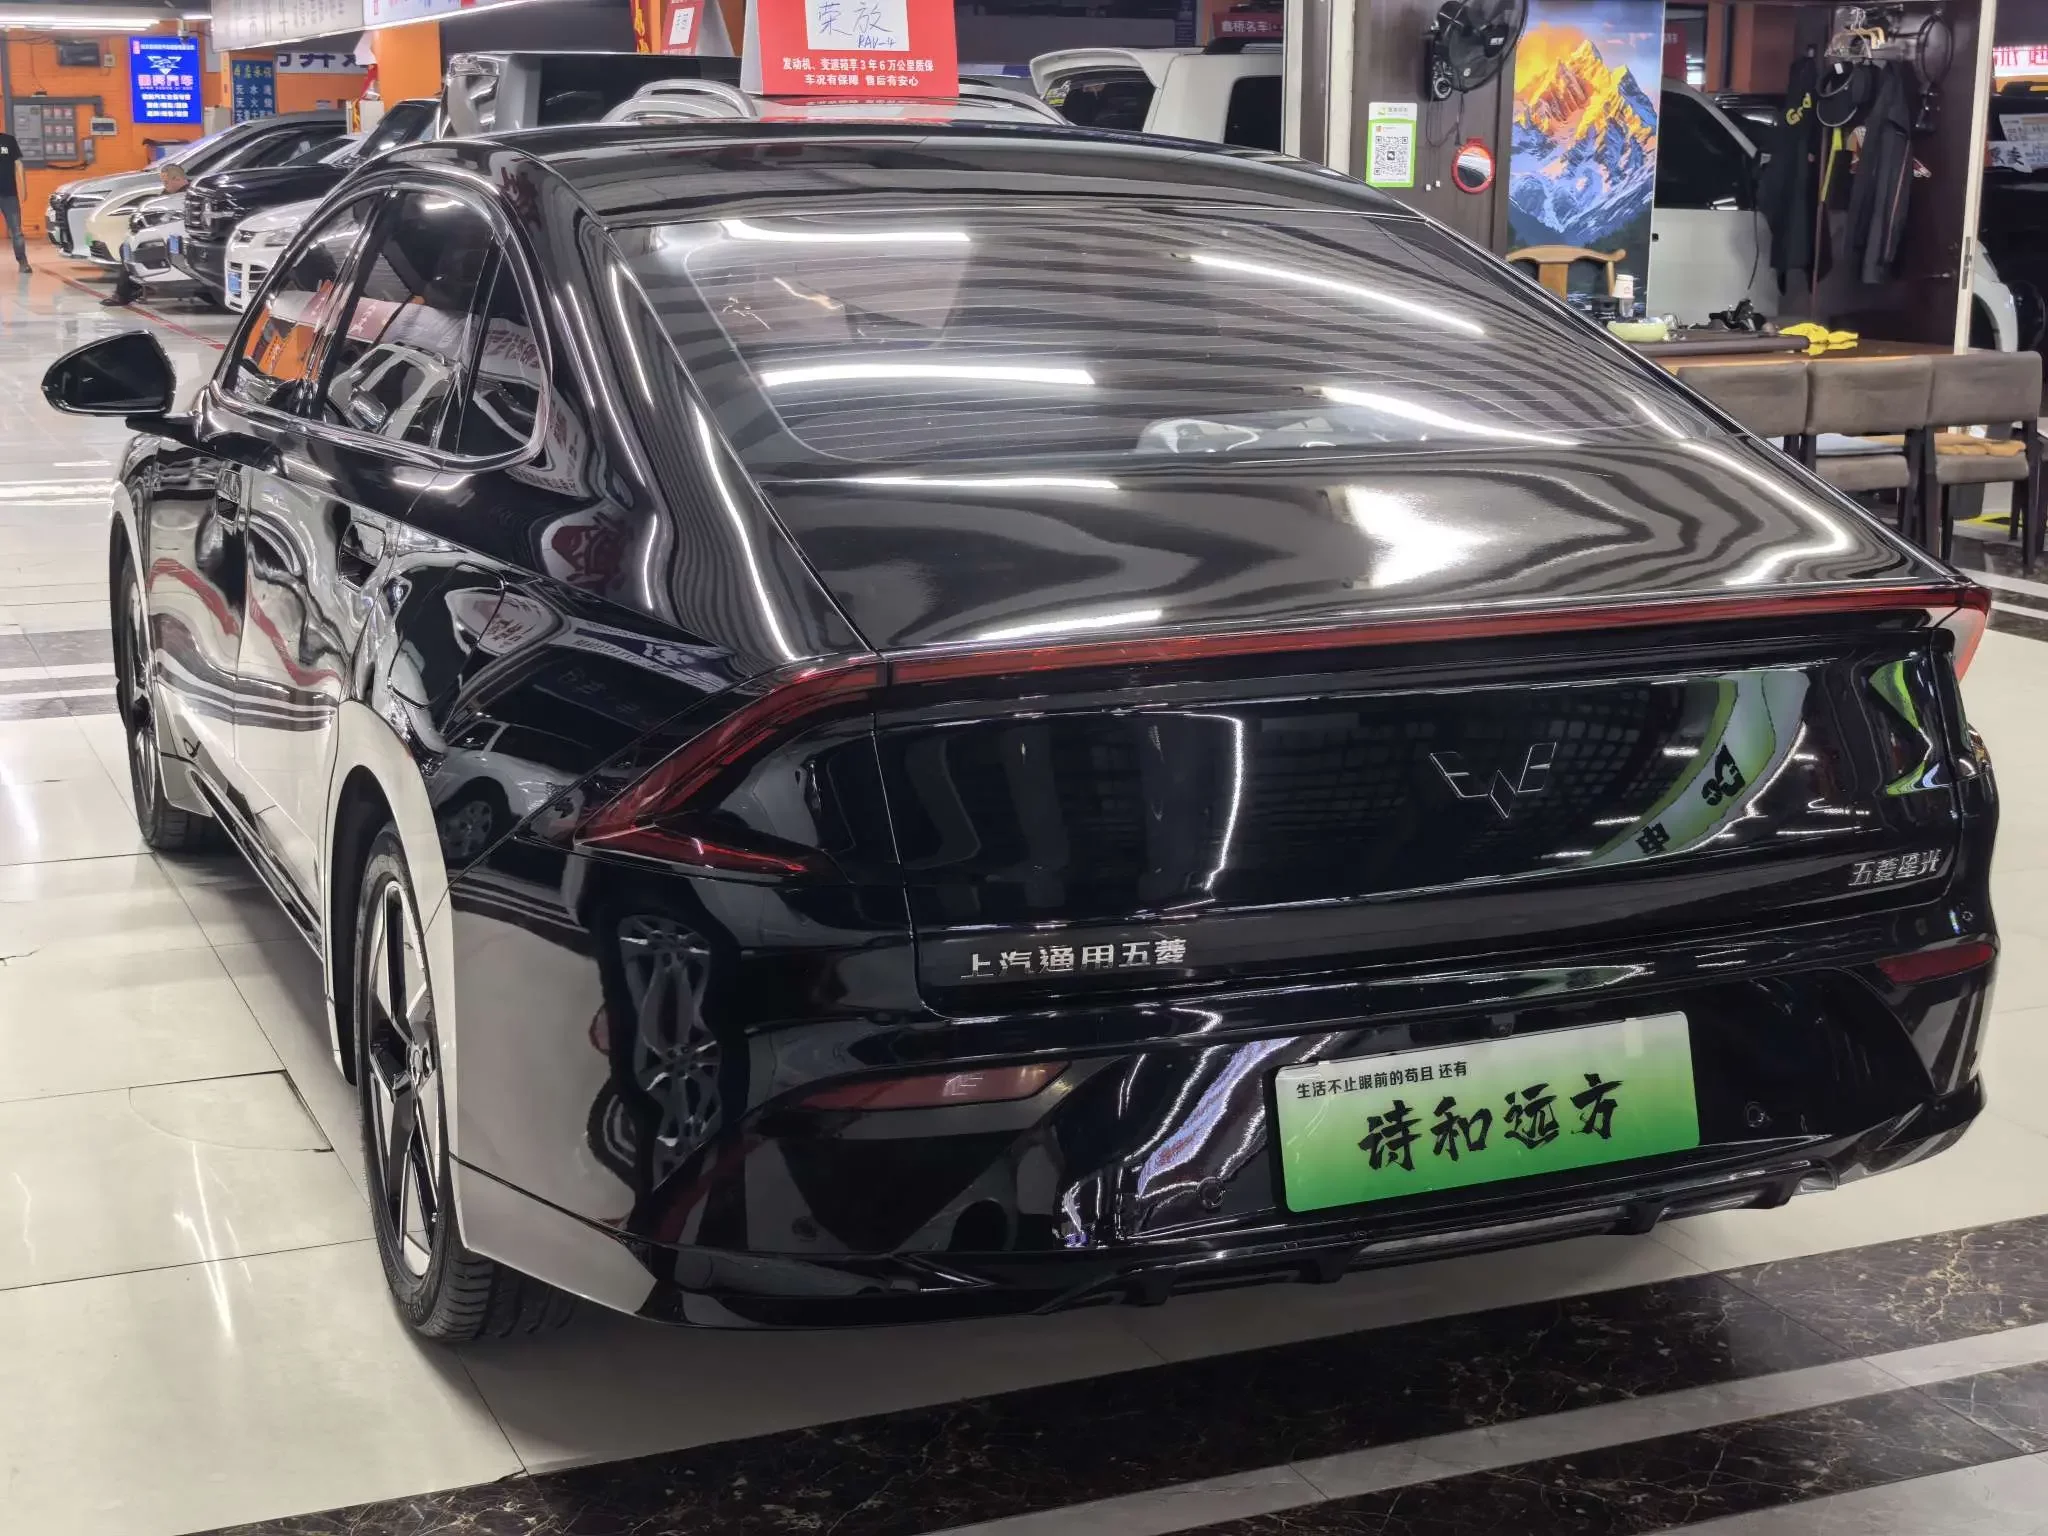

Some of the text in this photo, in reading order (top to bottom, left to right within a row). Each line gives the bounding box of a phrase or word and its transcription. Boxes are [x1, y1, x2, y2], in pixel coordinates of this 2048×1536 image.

[817, 1, 893, 36] 荣放
[1848, 847, 1943, 887] 五菱星光
[960, 936, 1187, 980] 上汽通用五菱
[1296, 1061, 1468, 1099] 生活不止眼前的苟且 还有
[1357, 1072, 1624, 1172] 诗和远方
